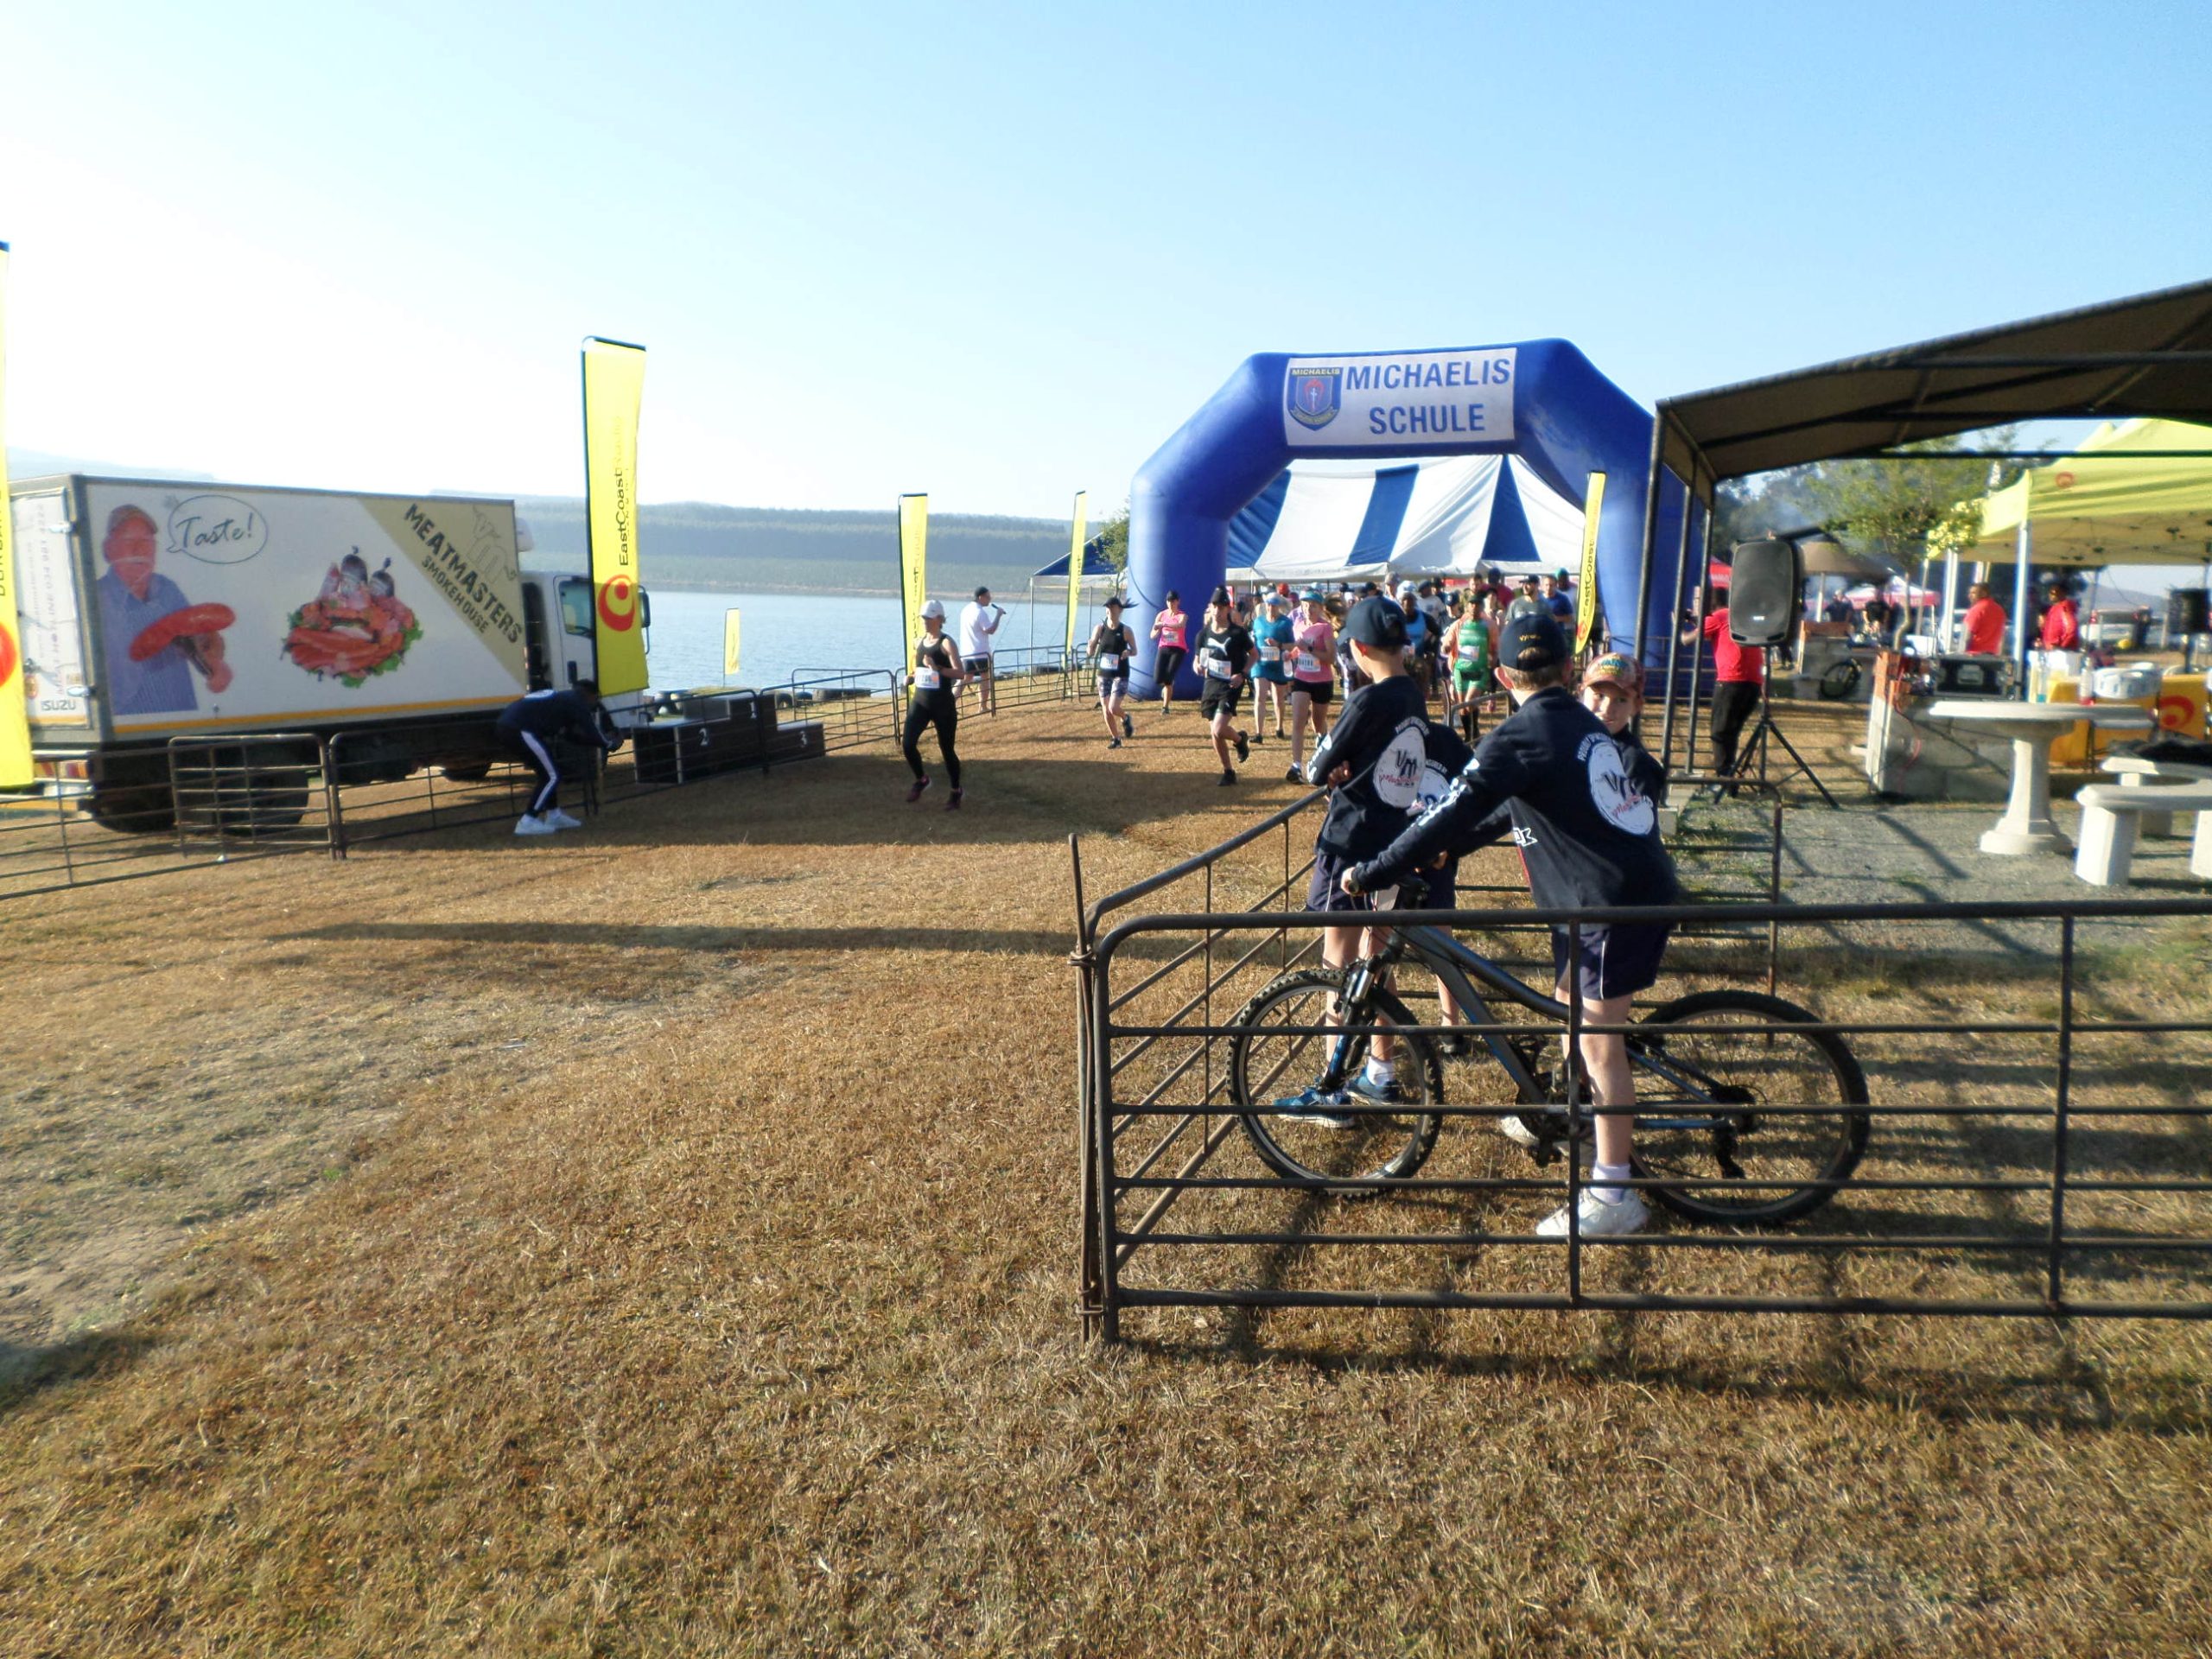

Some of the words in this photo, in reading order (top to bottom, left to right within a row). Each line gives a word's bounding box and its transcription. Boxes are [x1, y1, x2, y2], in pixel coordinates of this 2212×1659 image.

[1345, 358, 1510, 390] MICHAELIS
[1370, 404, 1486, 435] SCHULE
[175, 513, 253, 549] Taste!
[404, 503, 523, 644] MEATMASTERS
[422, 555, 489, 634] SMOKEHOUSE
[749, 701, 757, 720] 1
[698, 728, 709, 747] 2
[799, 730, 808, 748] 3
